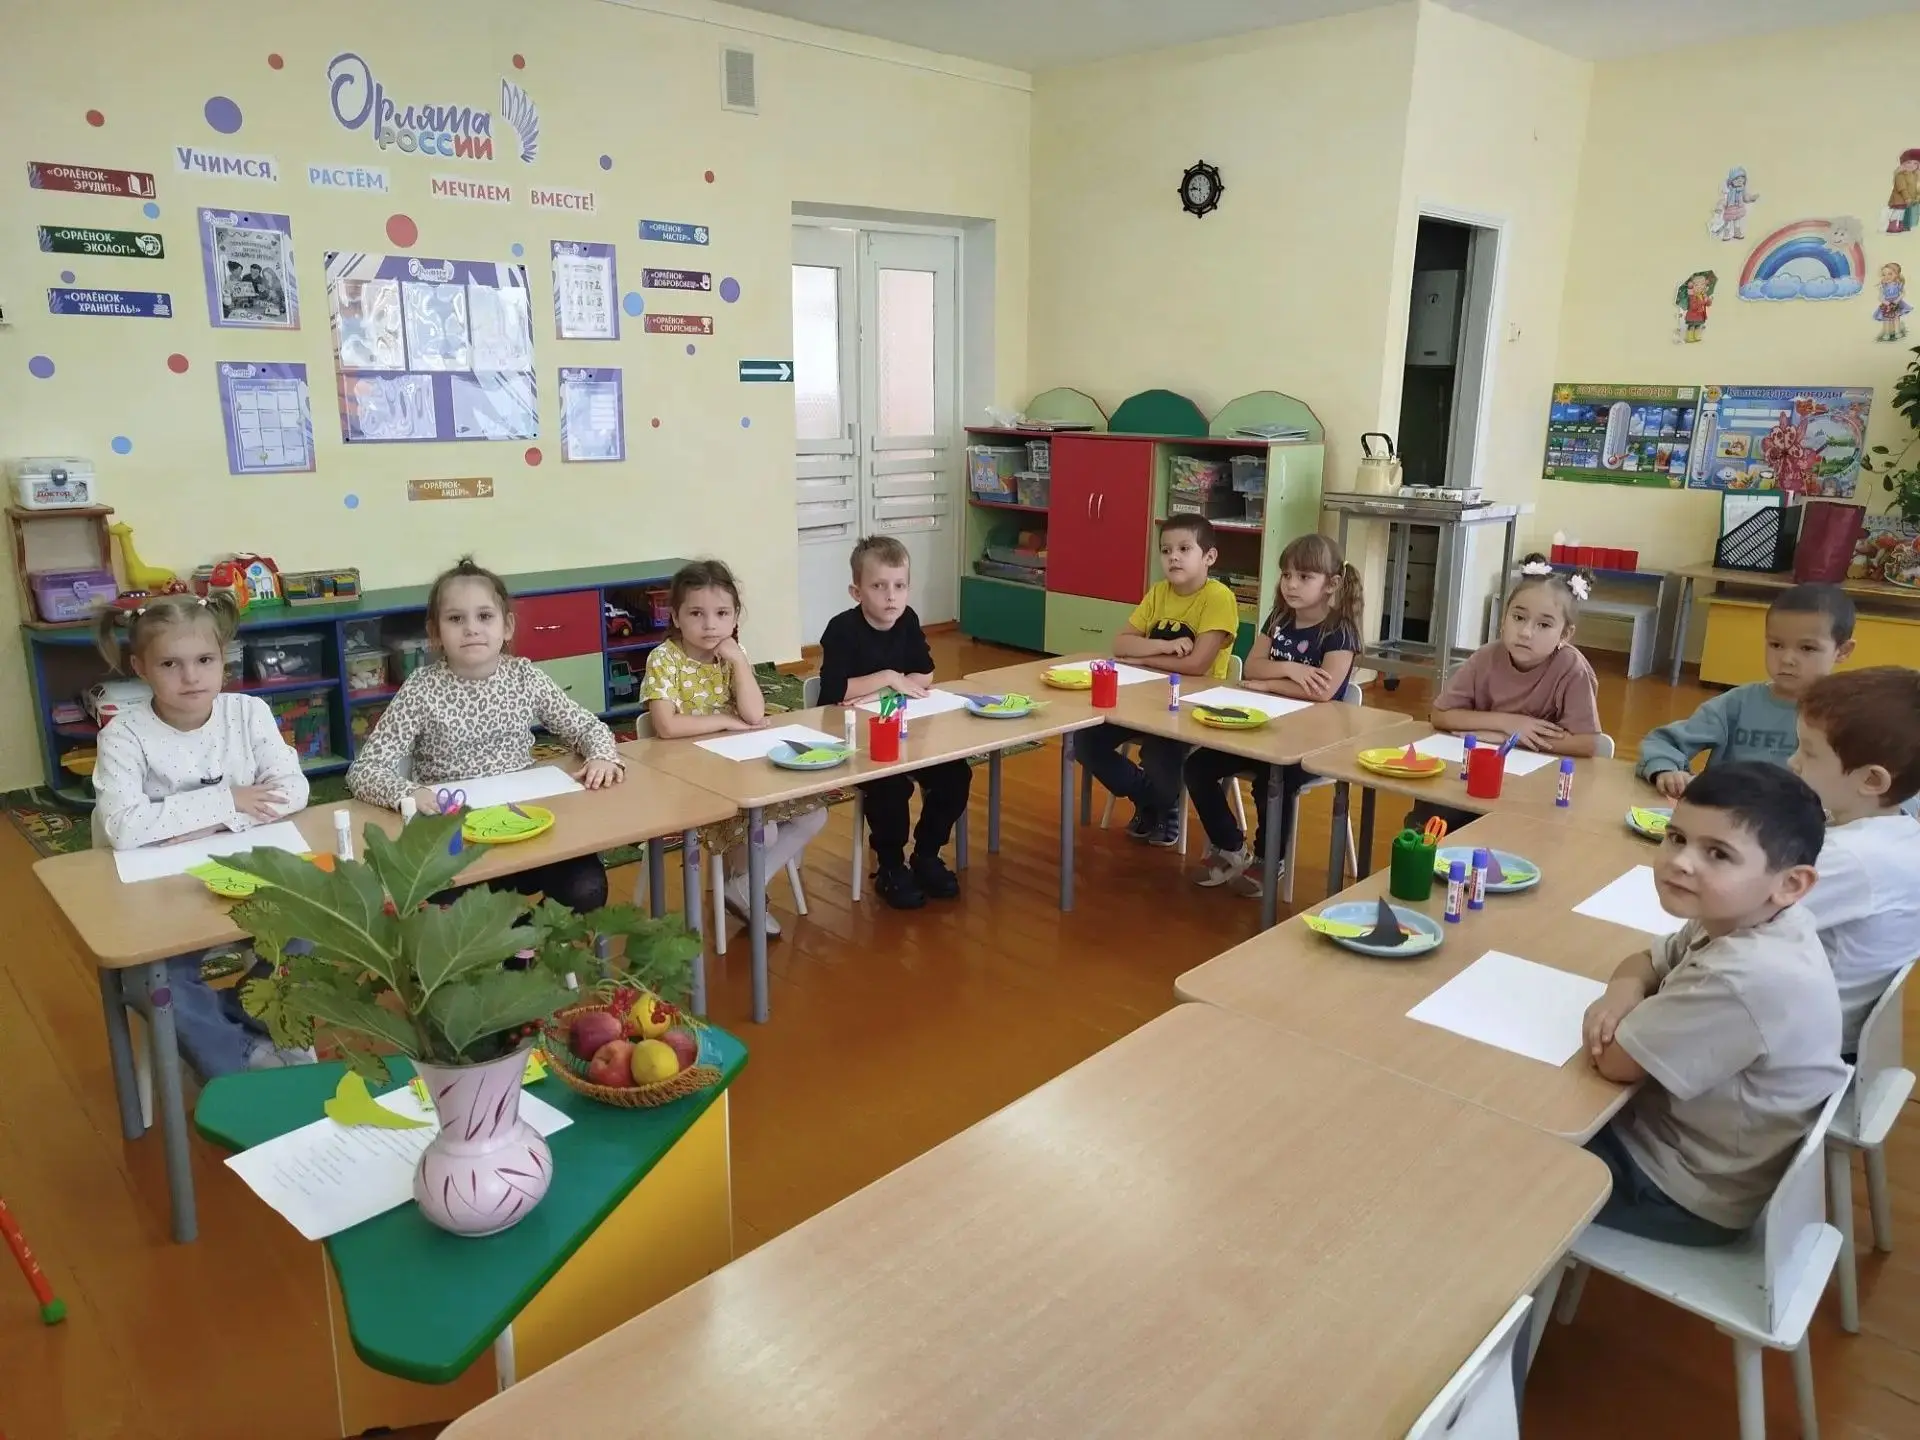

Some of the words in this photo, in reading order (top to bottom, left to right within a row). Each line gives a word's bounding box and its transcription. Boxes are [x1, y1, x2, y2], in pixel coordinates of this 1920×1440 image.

[327, 53, 492, 140] Орлята
[378, 127, 493, 161] РОССИИ
[46, 167, 109, 182] «ОРЛЁНОК-
[73, 180, 122, 193] ЭРУДИТ!»
[309, 168, 389, 193] РАСТЁМ,
[431, 178, 511, 202] МЕЧТАЕМ
[531, 189, 594, 211] ВМЕСТЕ!
[55, 230, 115, 242] «ОРЛЁНОК-
[83, 242, 136, 255] ЭКОЛОГ!»
[64, 291, 124, 303] «ОРЛЁНОК-
[79, 302, 141, 314] ХРАНИТЕЛЬ!»
